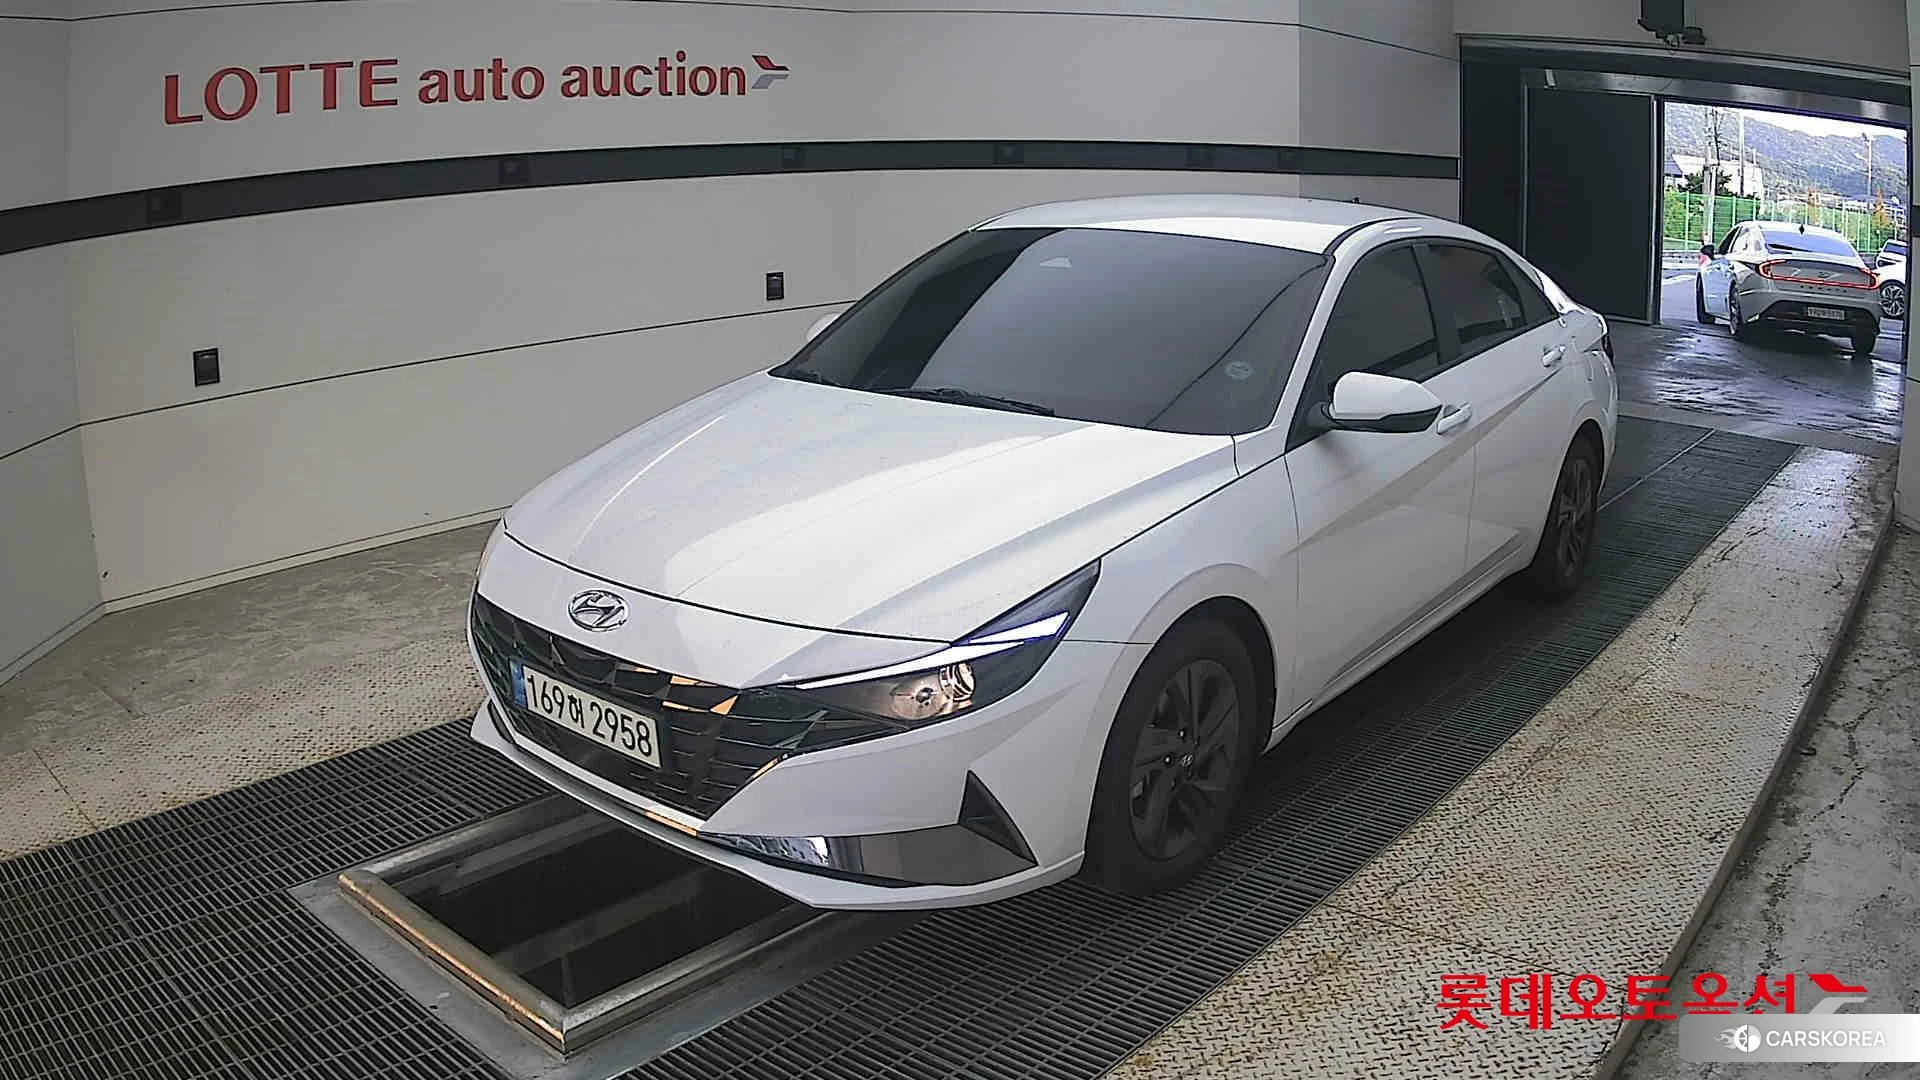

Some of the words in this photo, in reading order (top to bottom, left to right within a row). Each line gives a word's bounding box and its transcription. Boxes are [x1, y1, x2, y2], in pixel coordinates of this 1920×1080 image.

[164, 58, 399, 125] LOTTE
[418, 58, 545, 104] auto
[560, 50, 746, 97] auction
[589, 701, 653, 757] 2958
